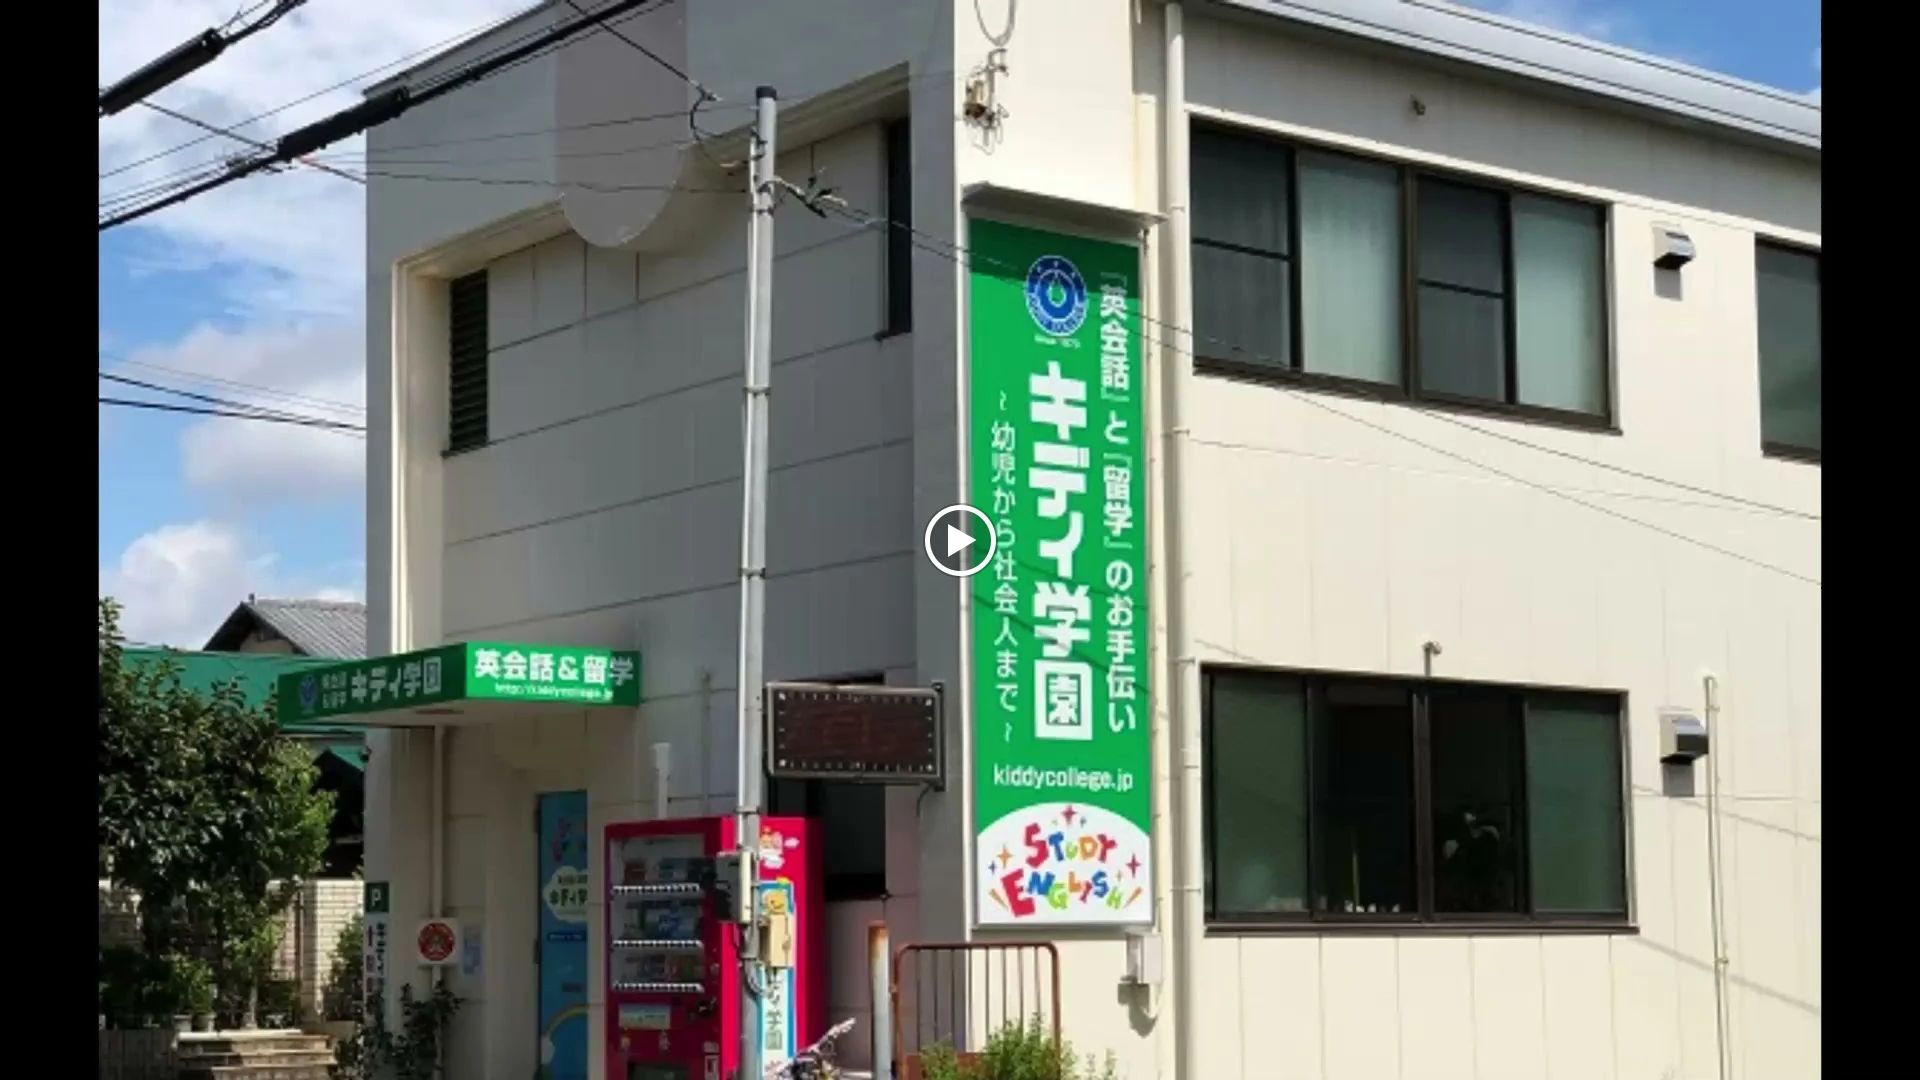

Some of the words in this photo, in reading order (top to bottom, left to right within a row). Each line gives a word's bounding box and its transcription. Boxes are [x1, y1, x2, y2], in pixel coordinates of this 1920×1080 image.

[1028, 360, 1093, 741] キディ学園
[993, 763, 1134, 792] kiddycollege.jp
